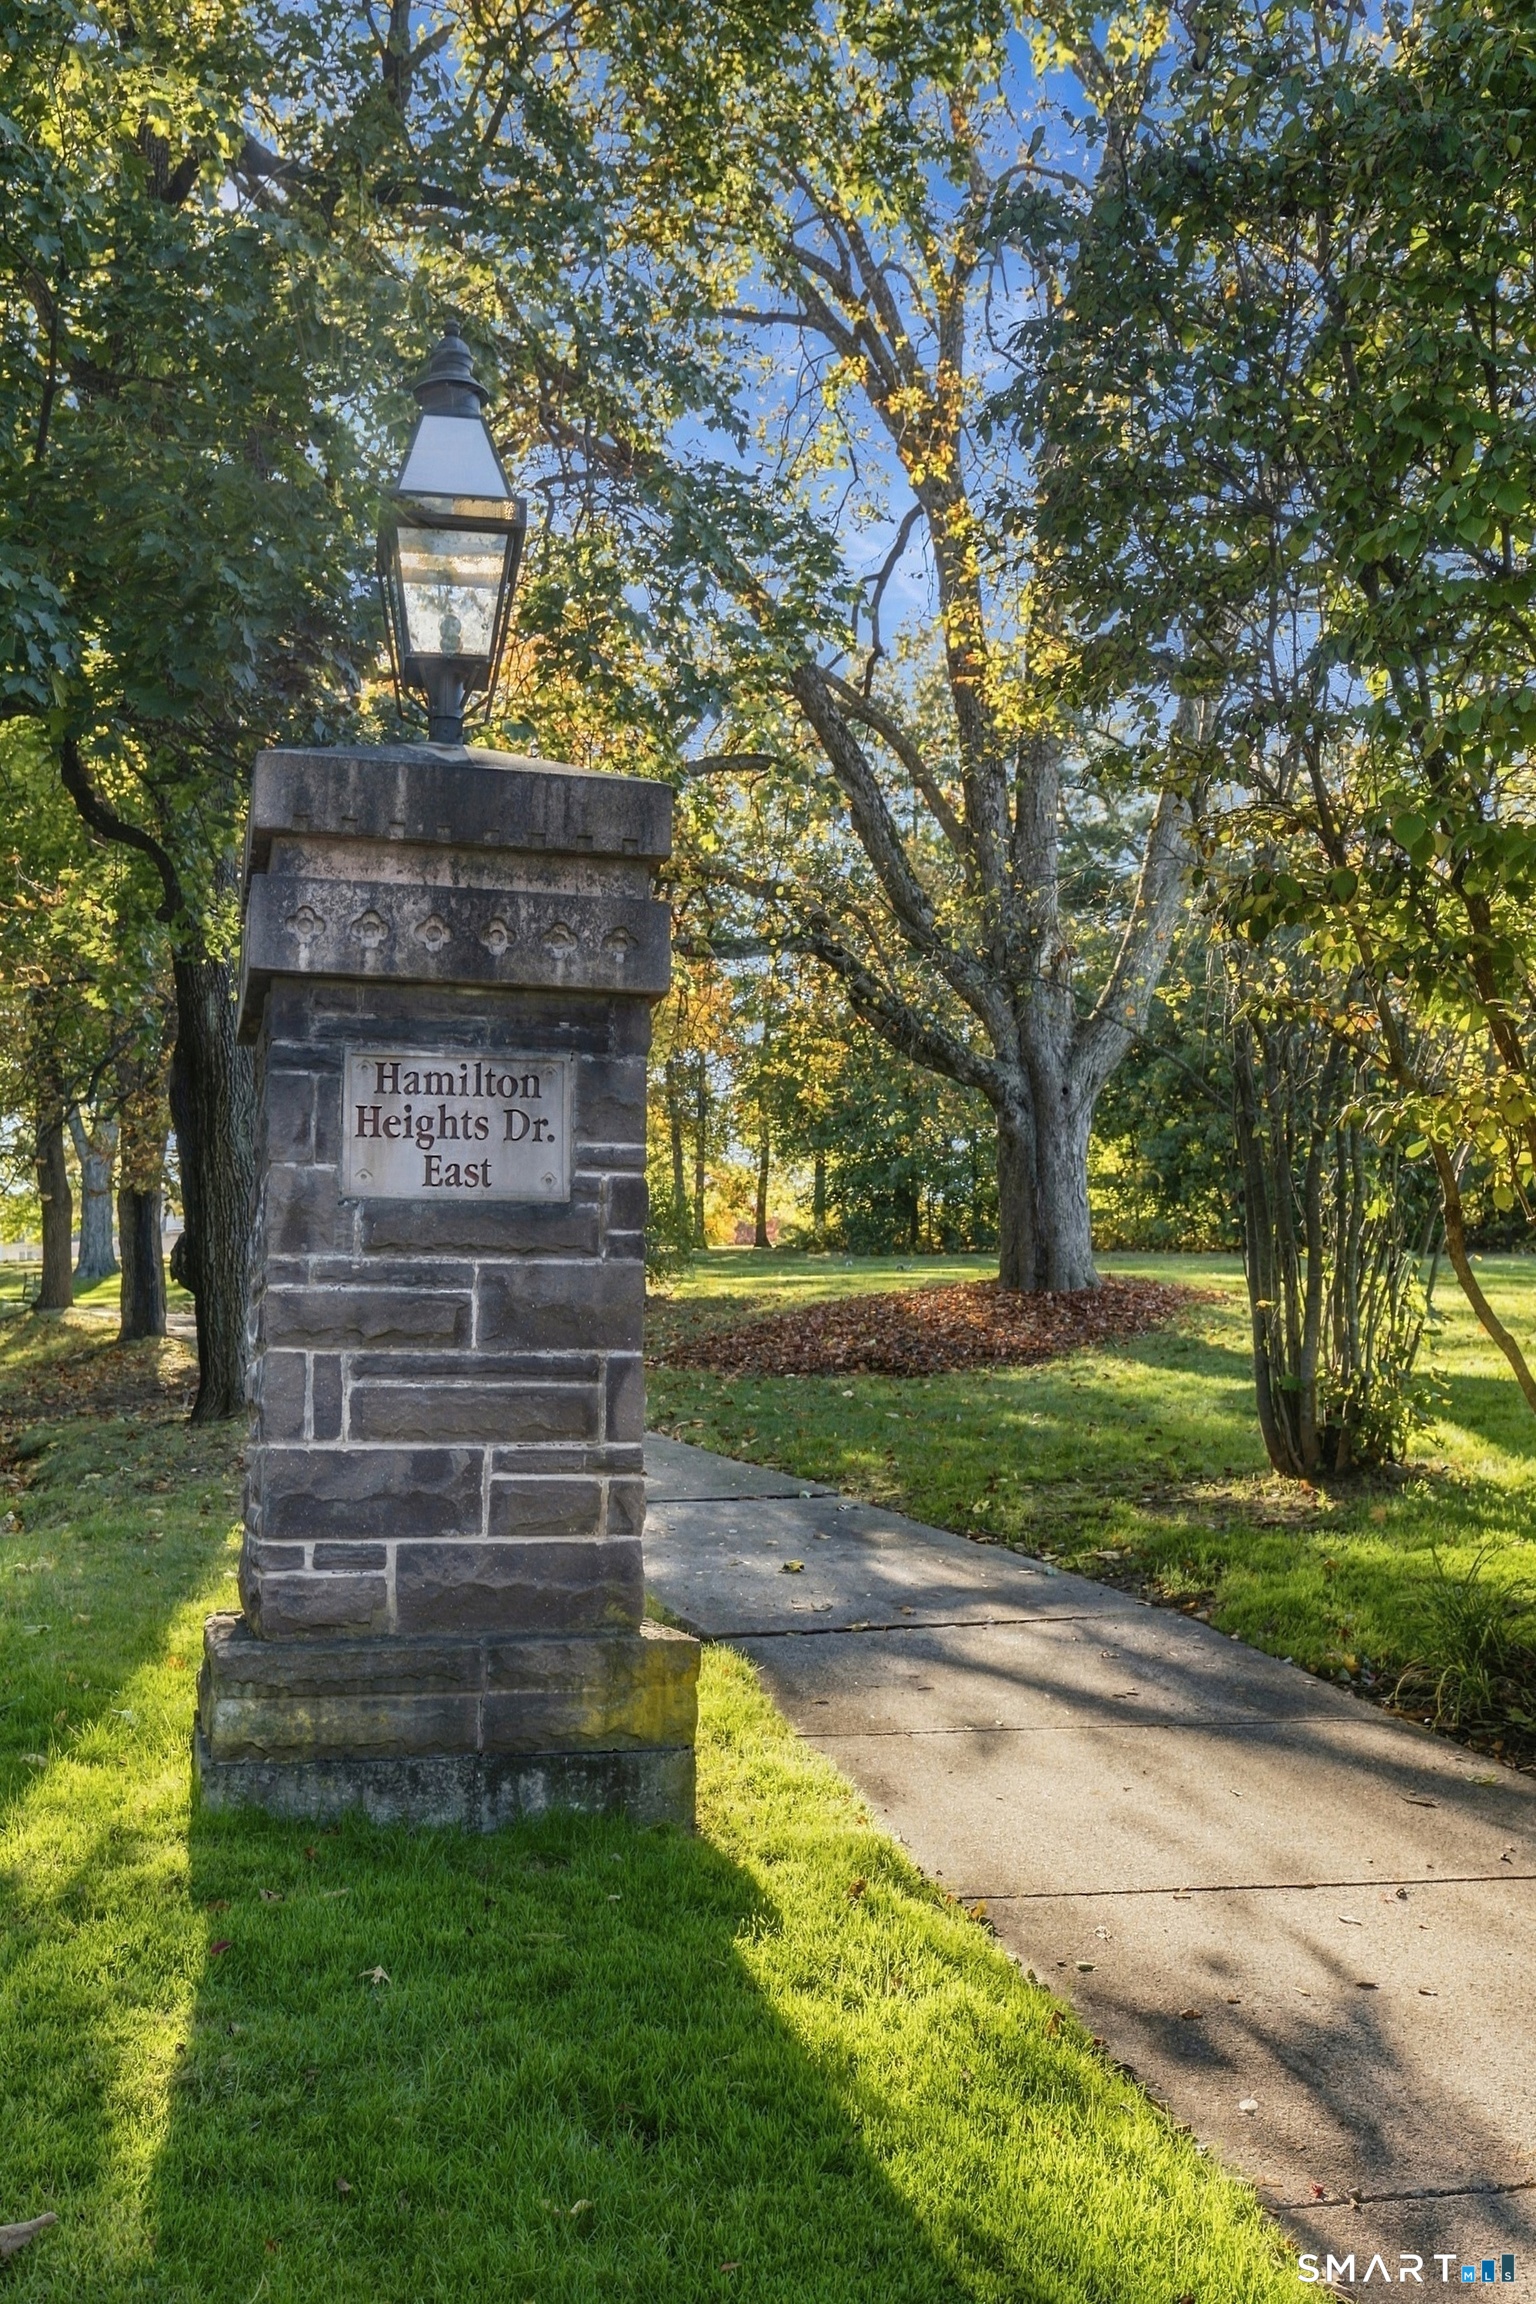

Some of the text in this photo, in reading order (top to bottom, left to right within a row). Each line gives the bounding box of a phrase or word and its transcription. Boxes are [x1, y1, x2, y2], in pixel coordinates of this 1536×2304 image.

[374, 1062, 542, 1099] Hamilton
[355, 1103, 556, 1150] Heights Dr.
[422, 1154, 493, 1188] East
